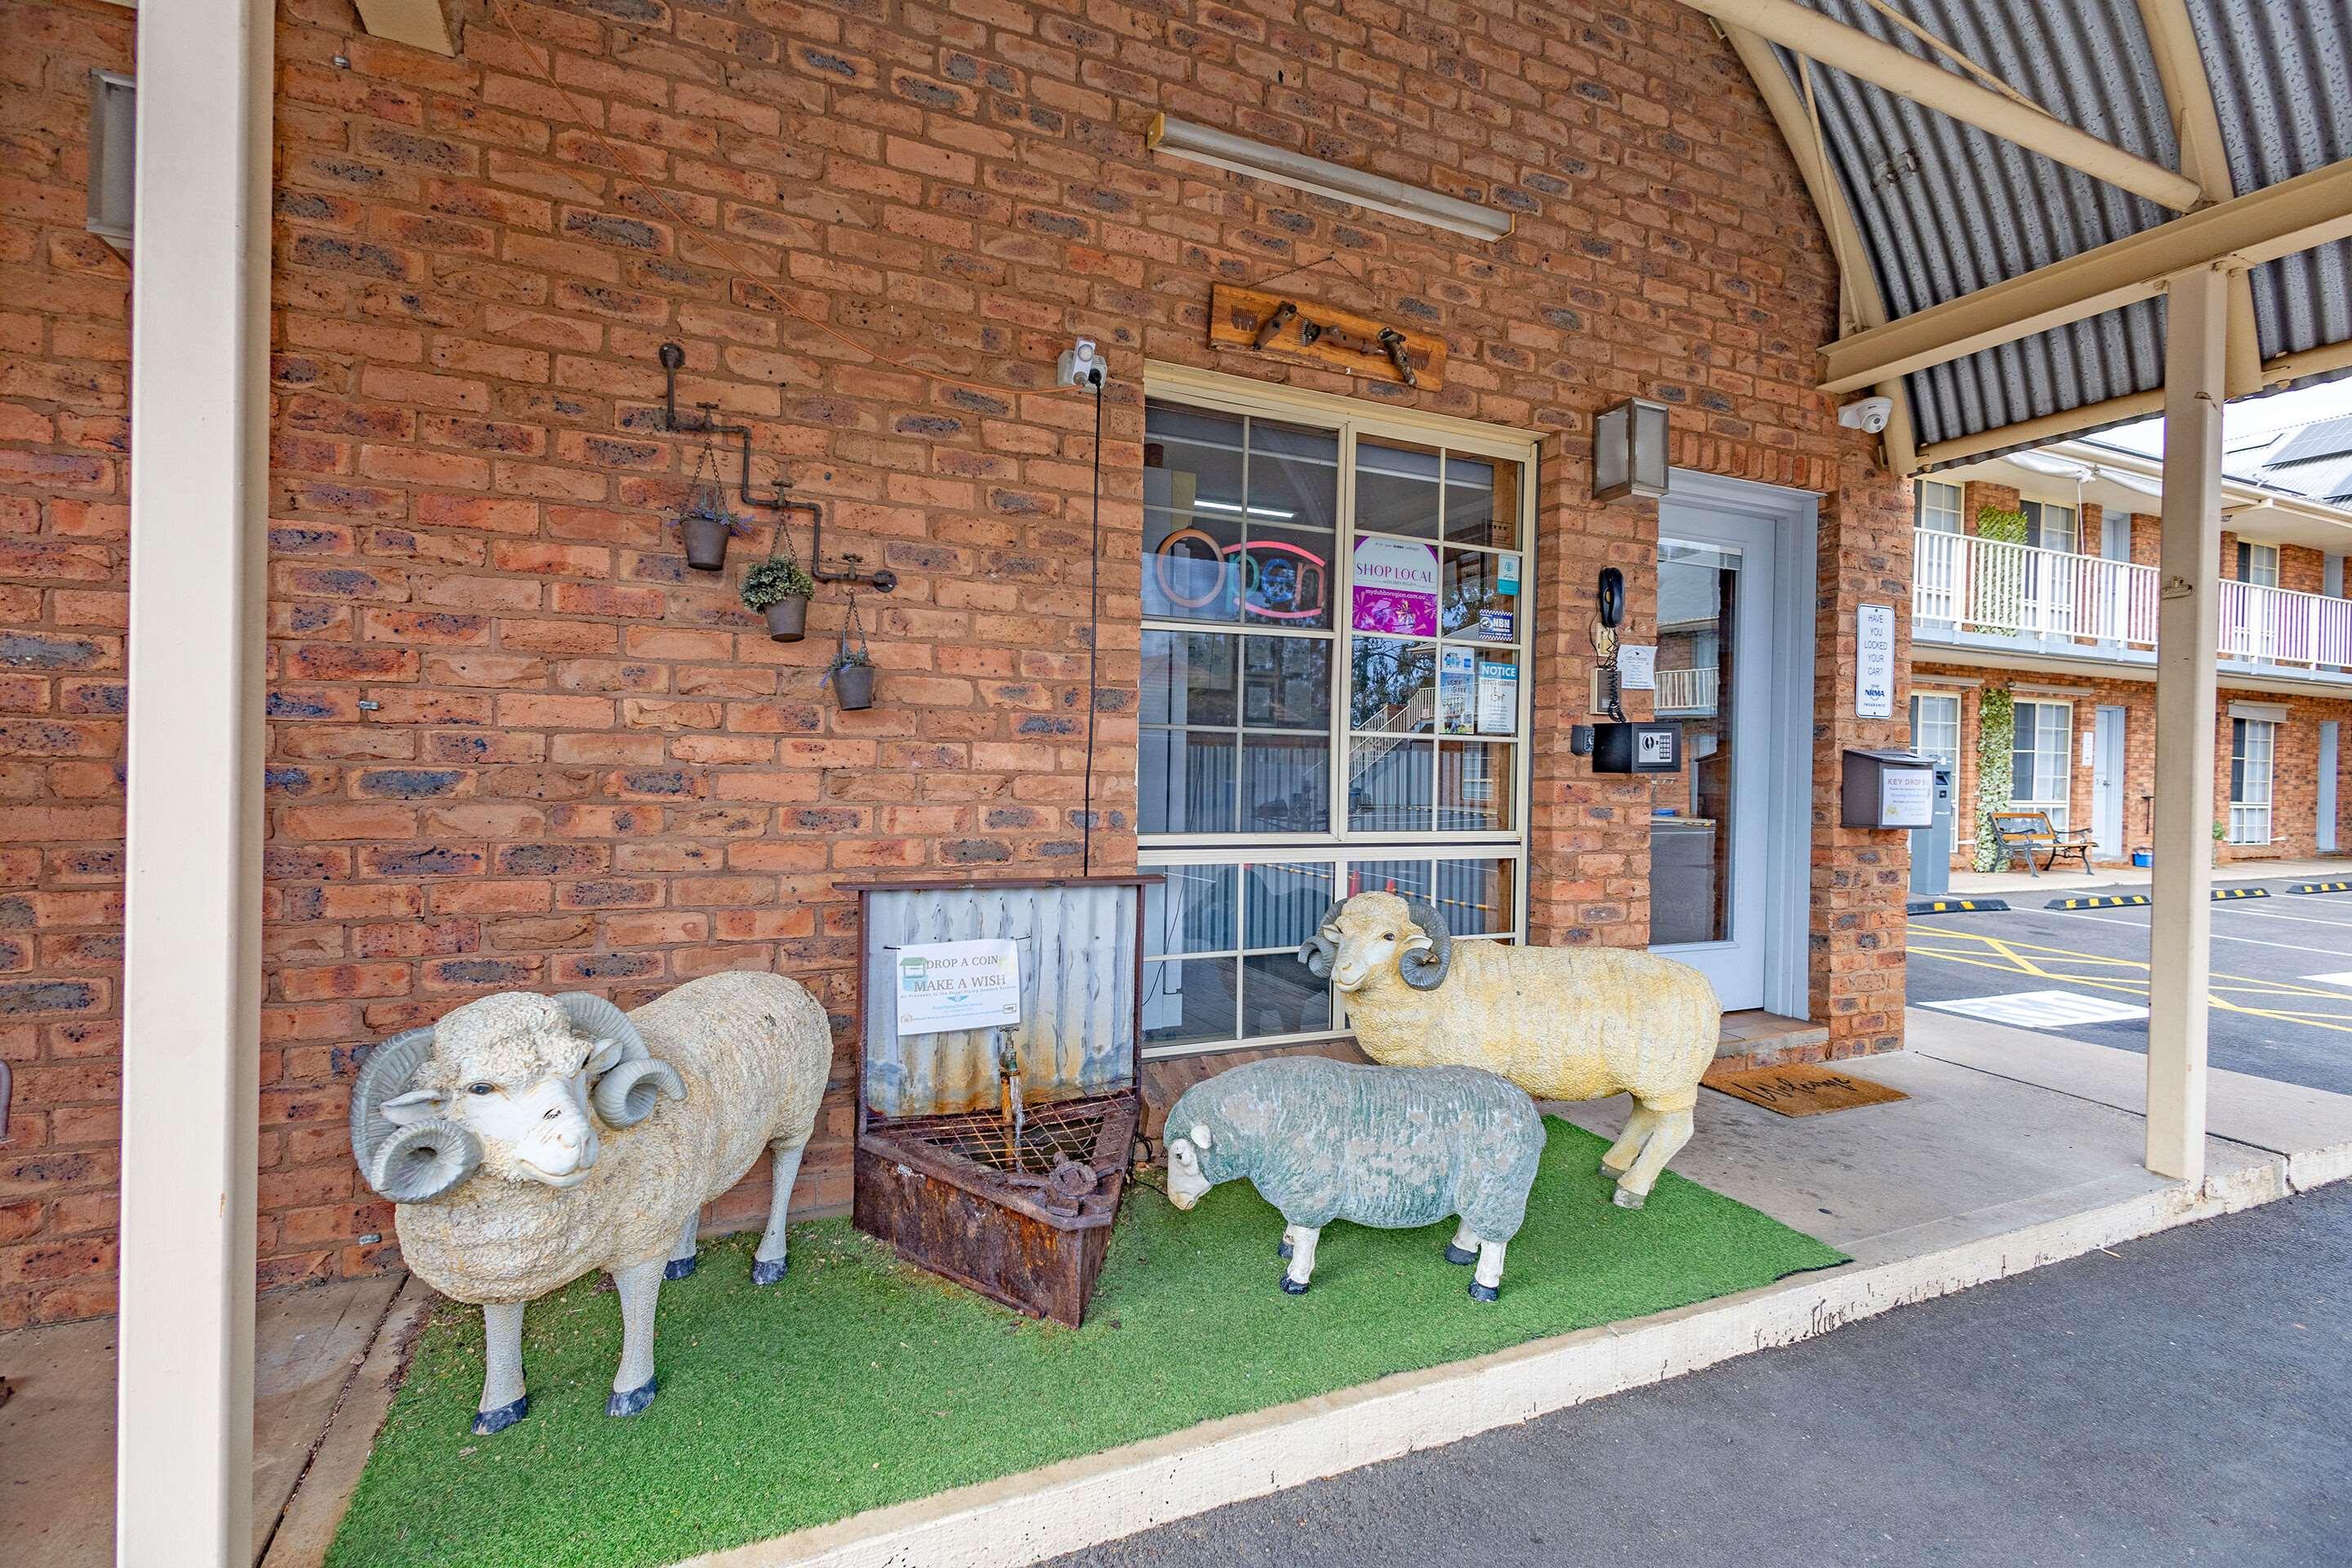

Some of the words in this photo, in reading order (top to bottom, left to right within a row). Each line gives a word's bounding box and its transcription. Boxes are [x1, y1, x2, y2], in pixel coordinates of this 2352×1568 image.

[1155, 528, 1325, 612] Open
[1356, 563, 1392, 577] SHOP
[1395, 568, 1435, 582] LOCAL
[1365, 589, 1426, 600] mydubboregion.com.au
[1493, 618, 1510, 628] NBN
[1868, 614, 1883, 623] HAVE
[1869, 627, 1882, 637] YOU
[1864, 640, 1887, 650] LOCKED
[1868, 653, 1884, 662] YOUR
[1481, 665, 1516, 677] NOTICE
[1868, 667, 1883, 676] CAR?
[1864, 689, 1885, 697] NRMA
[926, 959, 958, 969] DROP
[960, 957, 969, 966] A
[972, 956, 999, 966] COIN
[915, 979, 954, 992] MAKE
[958, 978, 967, 989] A
[972, 974, 1006, 987] WISH
[1731, 1076, 1858, 1102] Welcome
